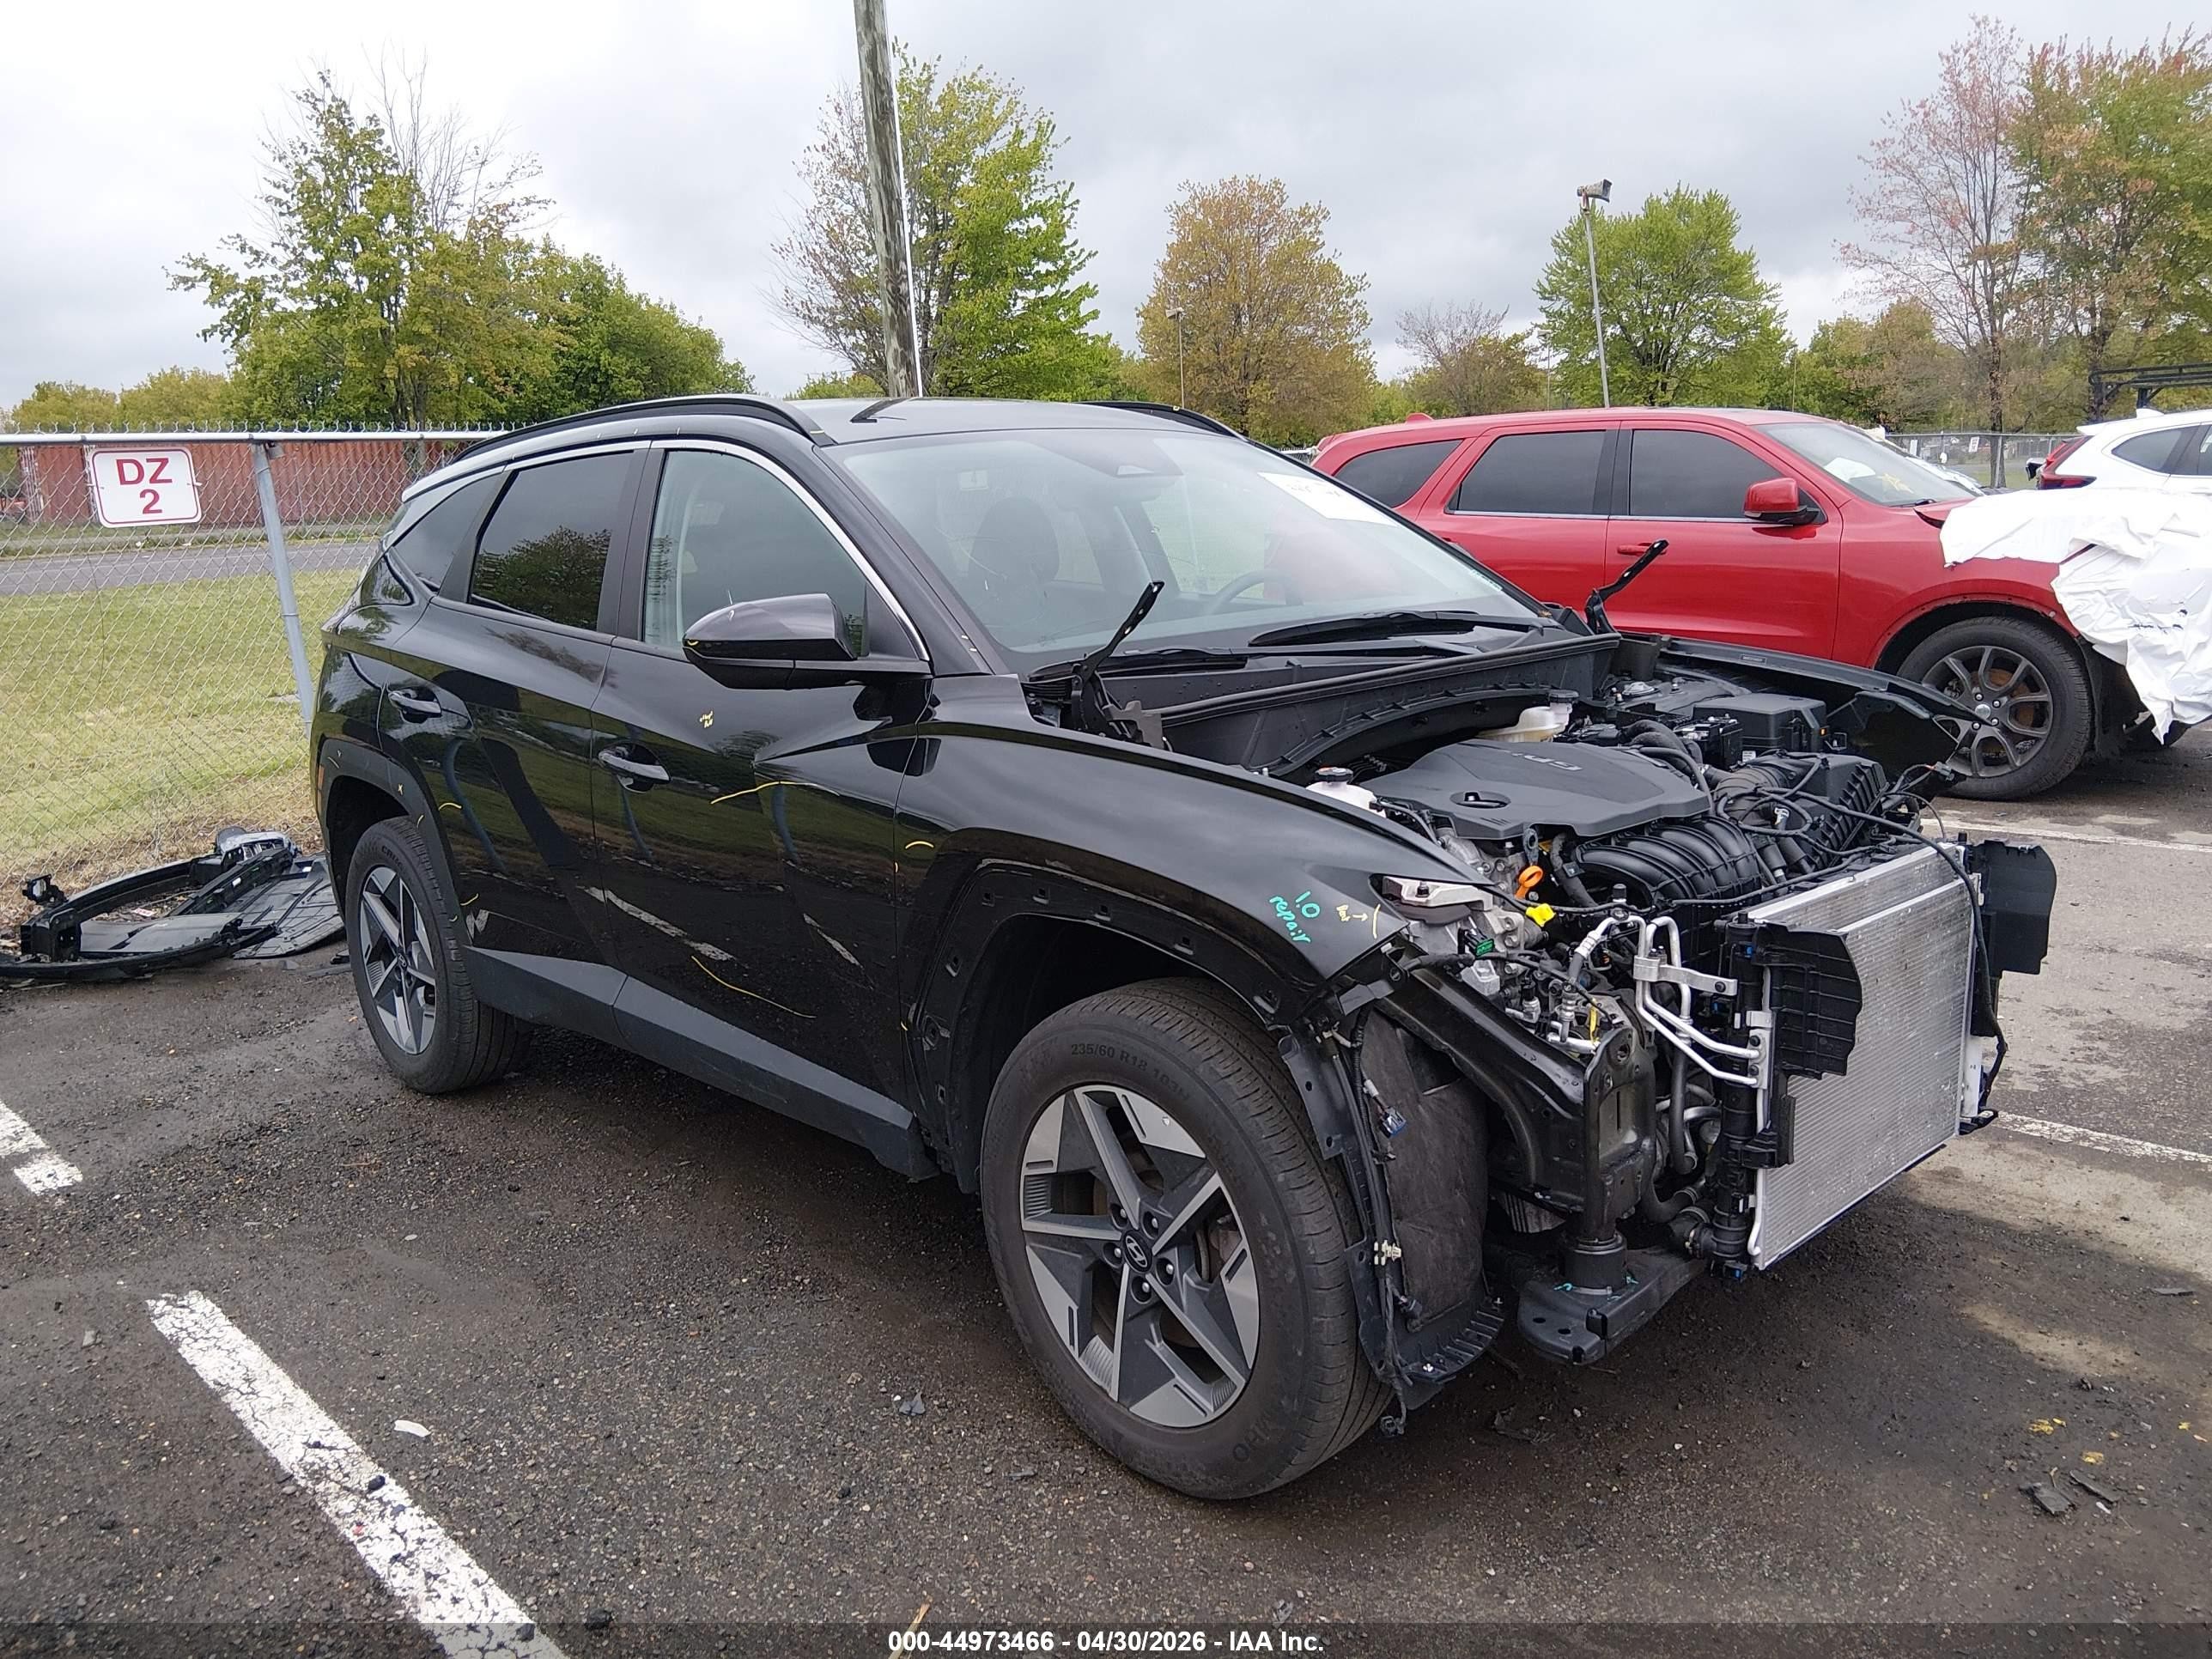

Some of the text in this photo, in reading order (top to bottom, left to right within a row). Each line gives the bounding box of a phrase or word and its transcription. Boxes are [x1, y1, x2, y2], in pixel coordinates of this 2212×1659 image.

[116, 458, 173, 485] DZ
[139, 489, 163, 514] 2
[1269, 896, 1311, 943] repair
[1071, 1043, 1115, 1059] 235/60
[1120, 1050, 1148, 1072] R18
